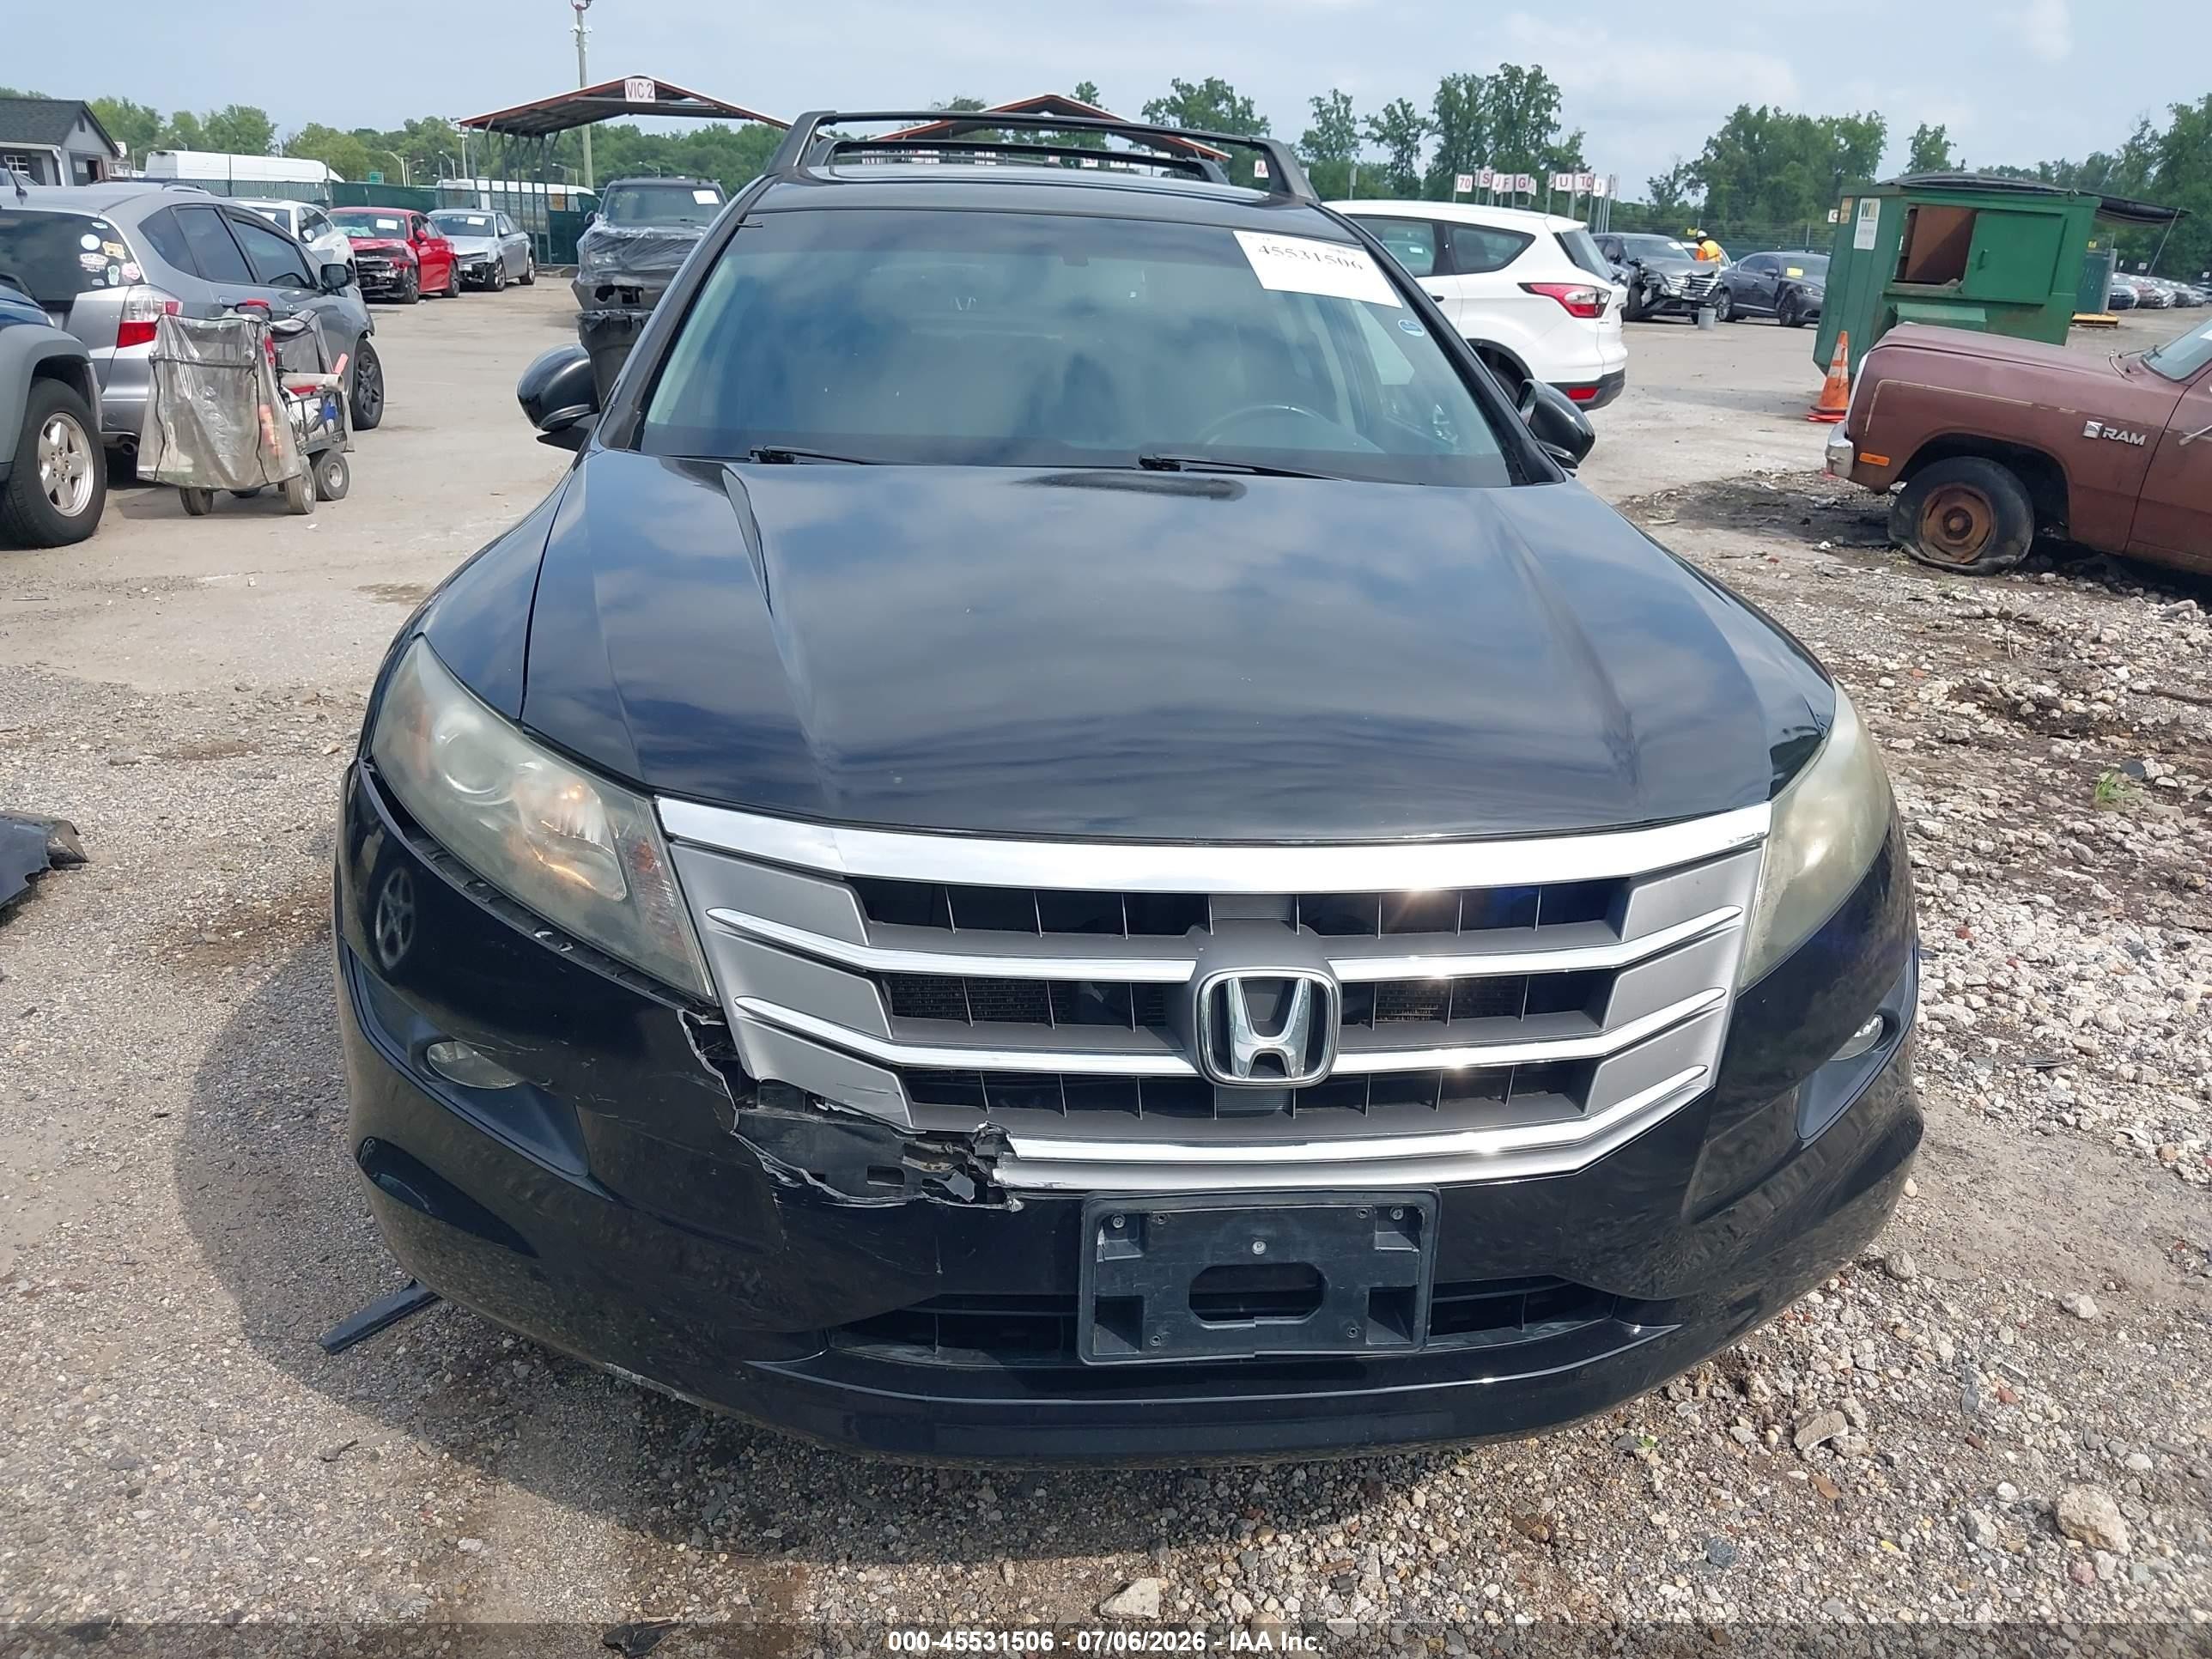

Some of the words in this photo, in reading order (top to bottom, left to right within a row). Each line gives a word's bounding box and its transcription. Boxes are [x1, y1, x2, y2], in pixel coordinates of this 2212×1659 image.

[626, 82, 644, 98] VIC
[647, 83, 653, 99] 2
[1460, 178, 1471, 189] 70
[1483, 173, 1490, 184] S
[1504, 177, 1510, 187] F
[1518, 177, 1526, 188] G
[1559, 176, 1568, 187] U
[1259, 245, 1364, 270] 45531506
[2101, 427, 2147, 447] RAM
